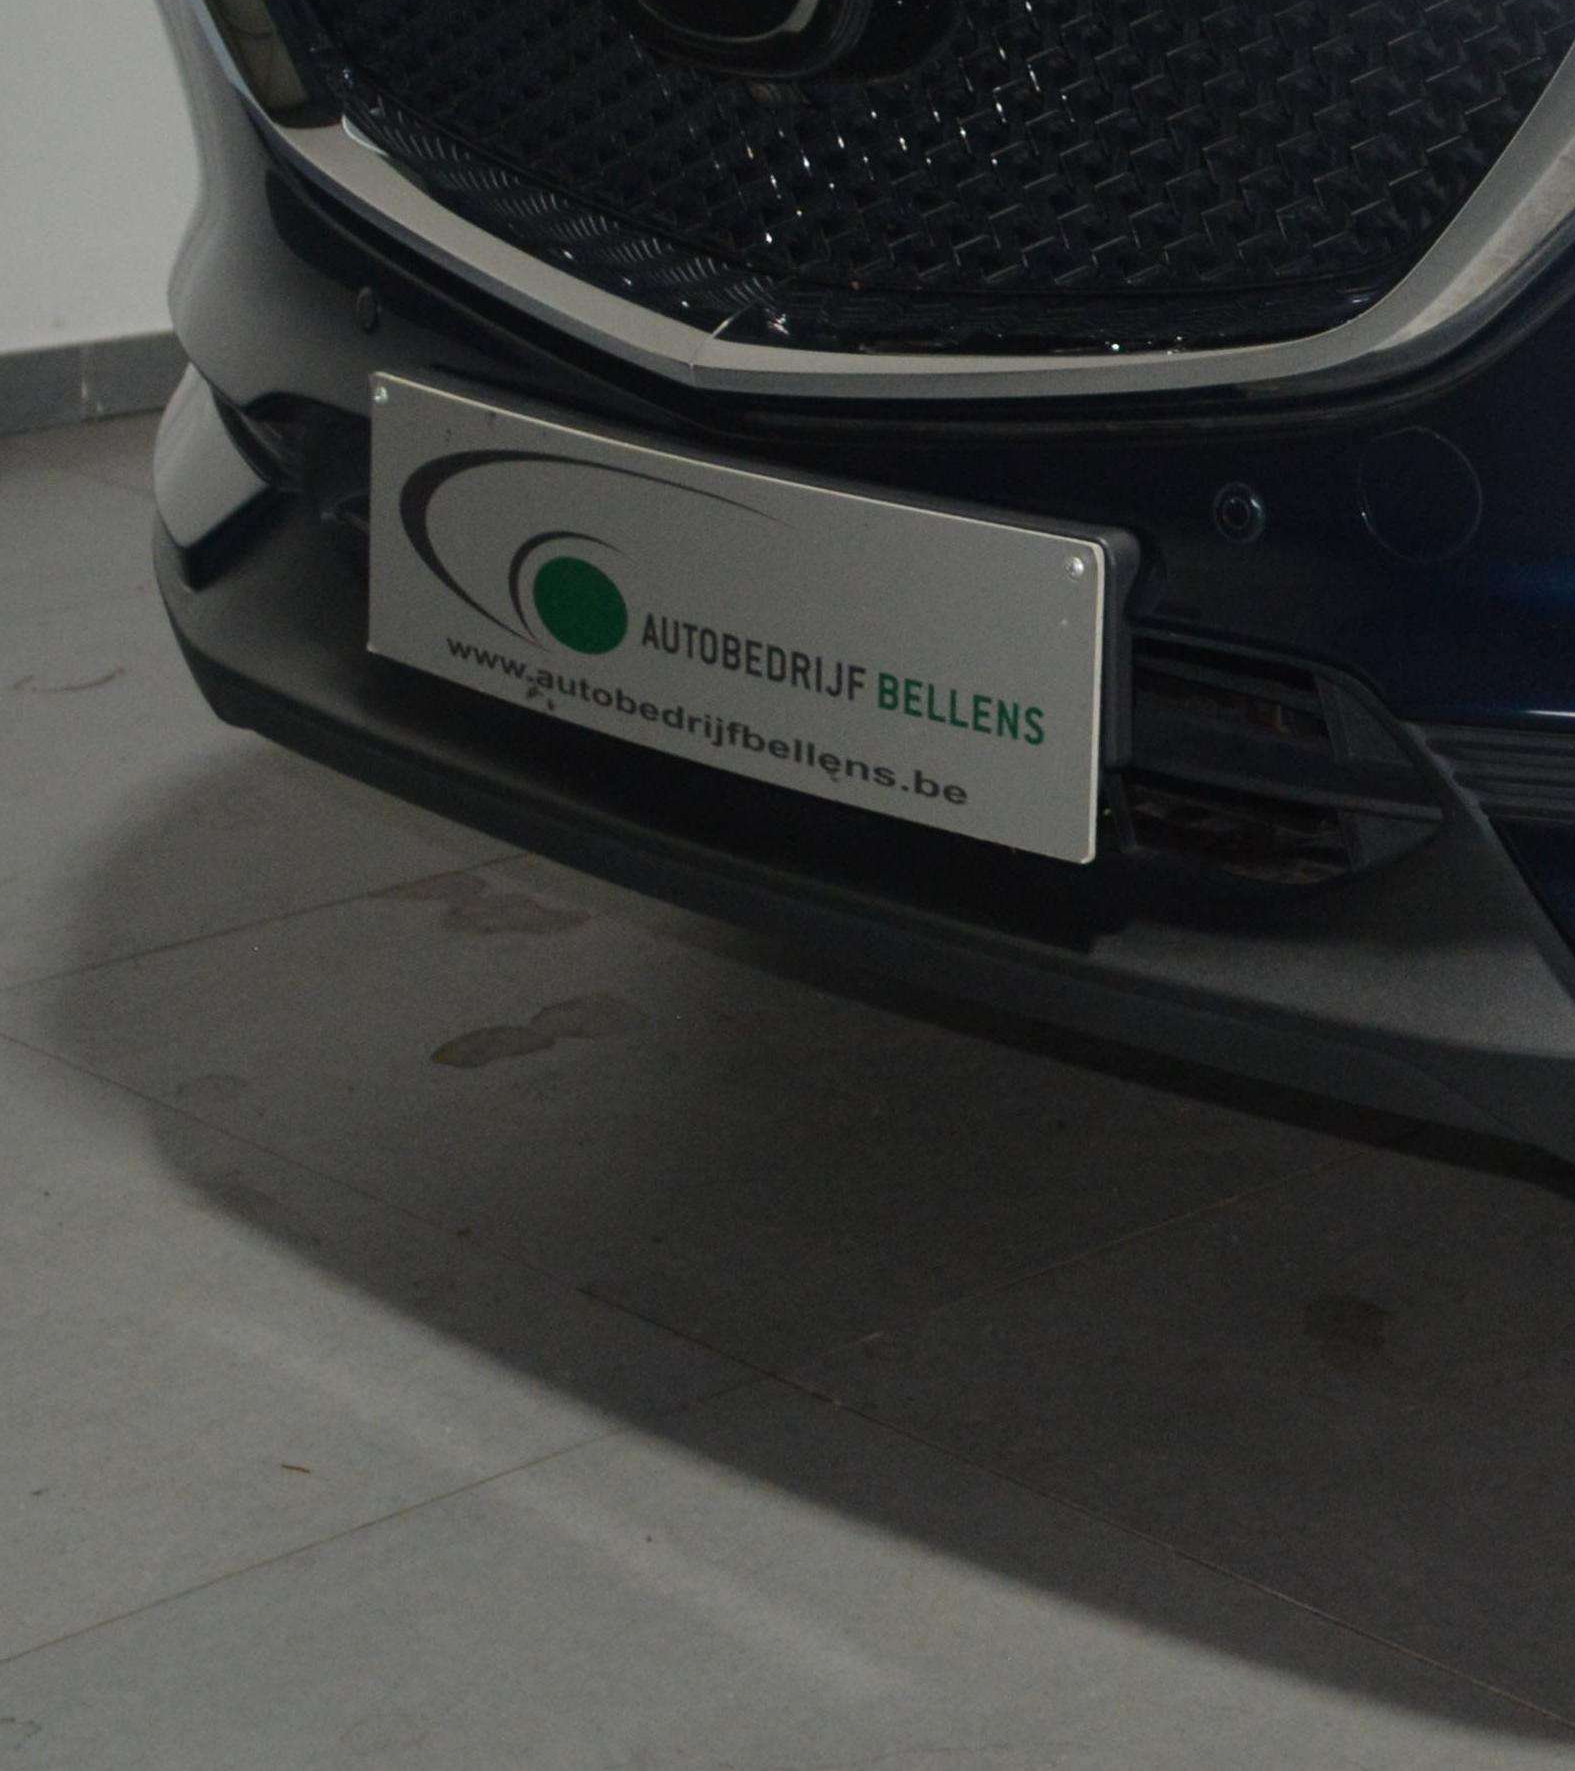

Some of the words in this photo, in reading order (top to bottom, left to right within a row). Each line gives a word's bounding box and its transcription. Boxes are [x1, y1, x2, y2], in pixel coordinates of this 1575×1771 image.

[446, 636, 968, 806] www.autobedrijfbellens.be
[641, 614, 868, 702] AUTOBEDRIJF
[877, 672, 1046, 746] BELLENS
